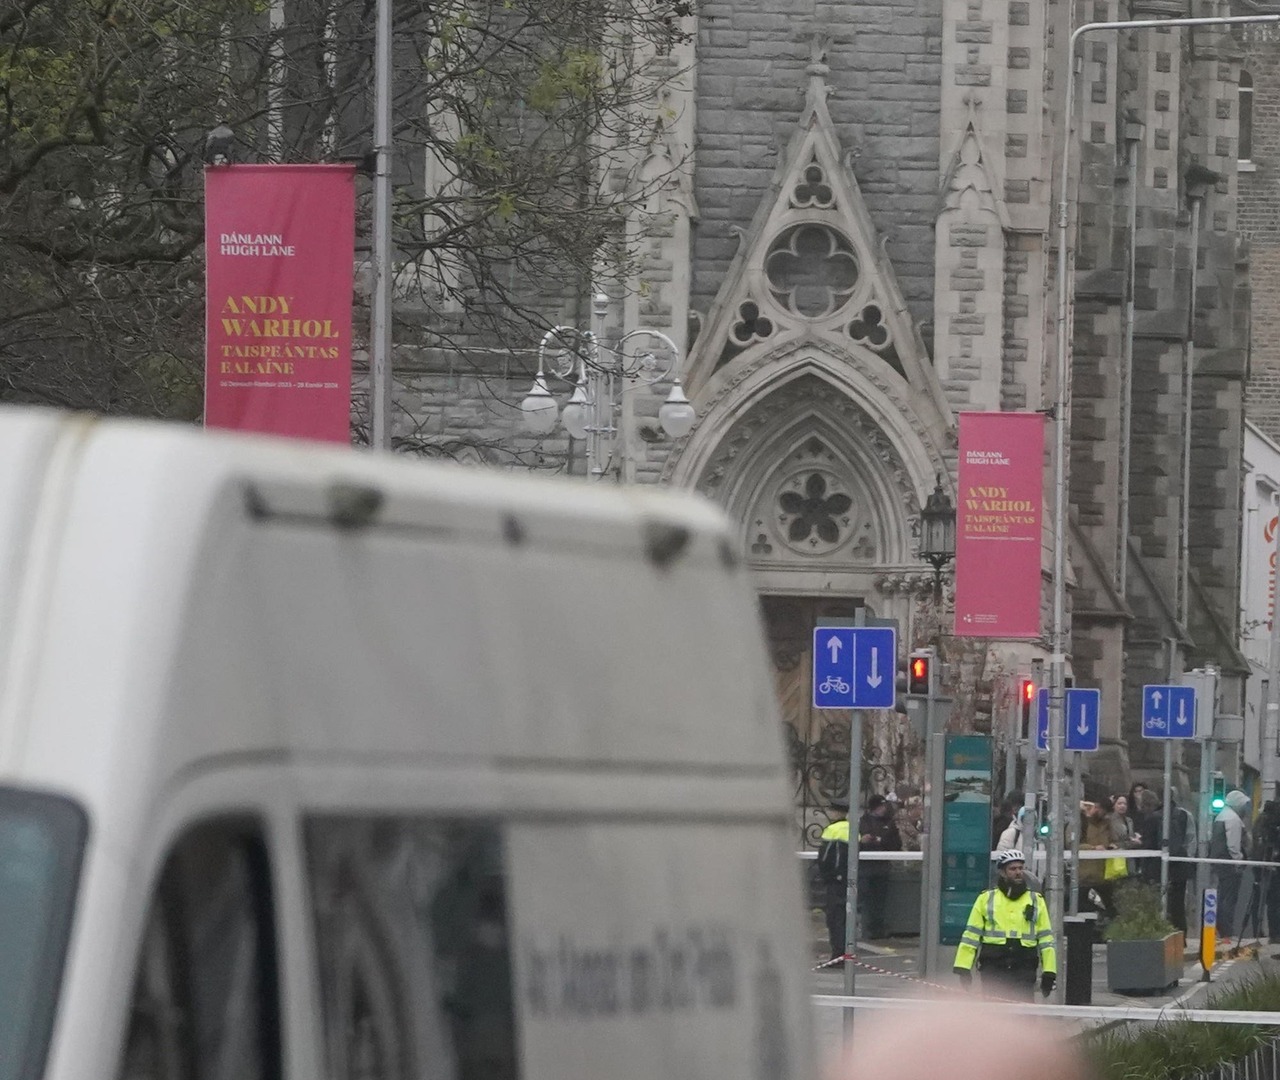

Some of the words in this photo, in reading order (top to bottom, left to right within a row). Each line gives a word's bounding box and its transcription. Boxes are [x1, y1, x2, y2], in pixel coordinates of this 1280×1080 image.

[220, 231, 283, 245] DÁNLANN
[220, 245, 260, 257] HUGH
[262, 246, 296, 257] LANE
[220, 295, 293, 314] ANDY
[220, 318, 339, 338] WARHOL
[221, 343, 339, 359] TAISPEÁNTAS
[220, 358, 294, 375] EALAÍNE
[966, 458, 990, 466] HUGH
[990, 458, 1010, 466] LANE
[967, 486, 1009, 498] ANDY
[966, 499, 1035, 513] WARHOL
